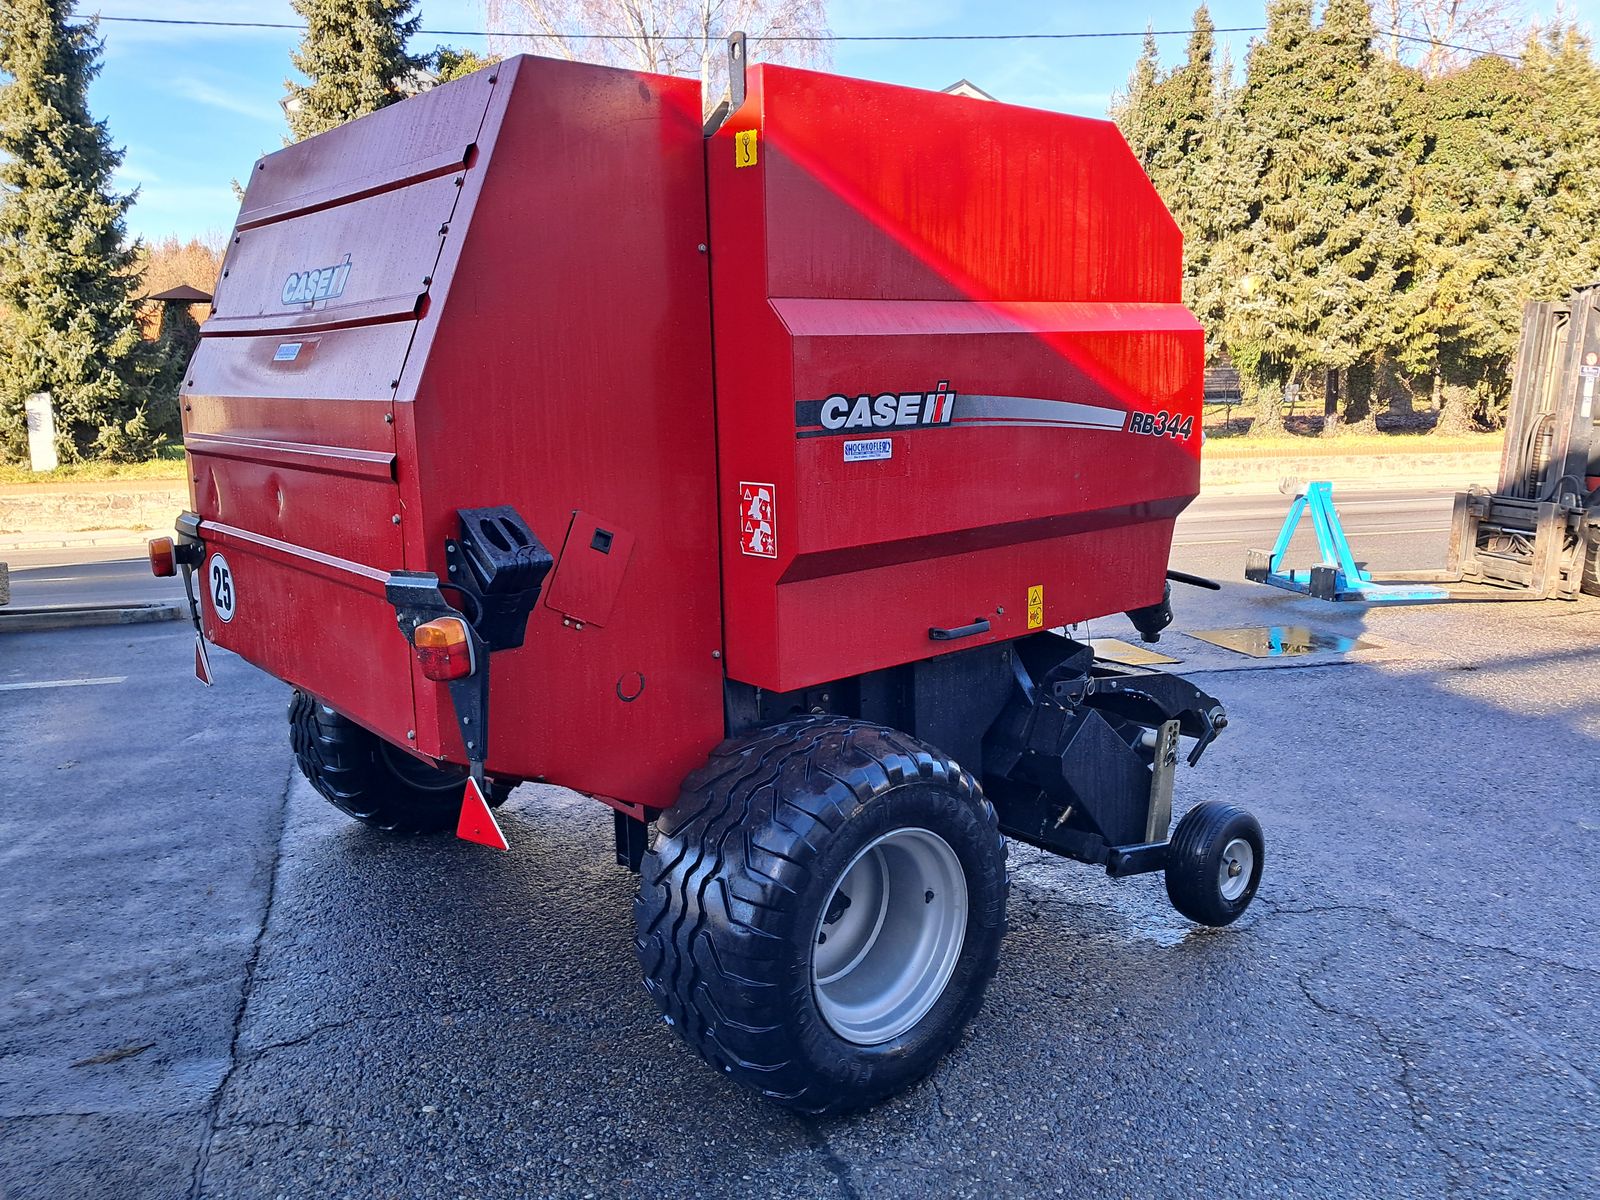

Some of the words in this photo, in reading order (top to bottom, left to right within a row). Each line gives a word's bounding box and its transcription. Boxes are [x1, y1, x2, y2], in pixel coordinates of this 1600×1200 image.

[282, 268, 333, 304] CASE
[820, 395, 922, 430] CASE
[1129, 410, 1194, 440] RB344
[213, 565, 231, 611] 25
